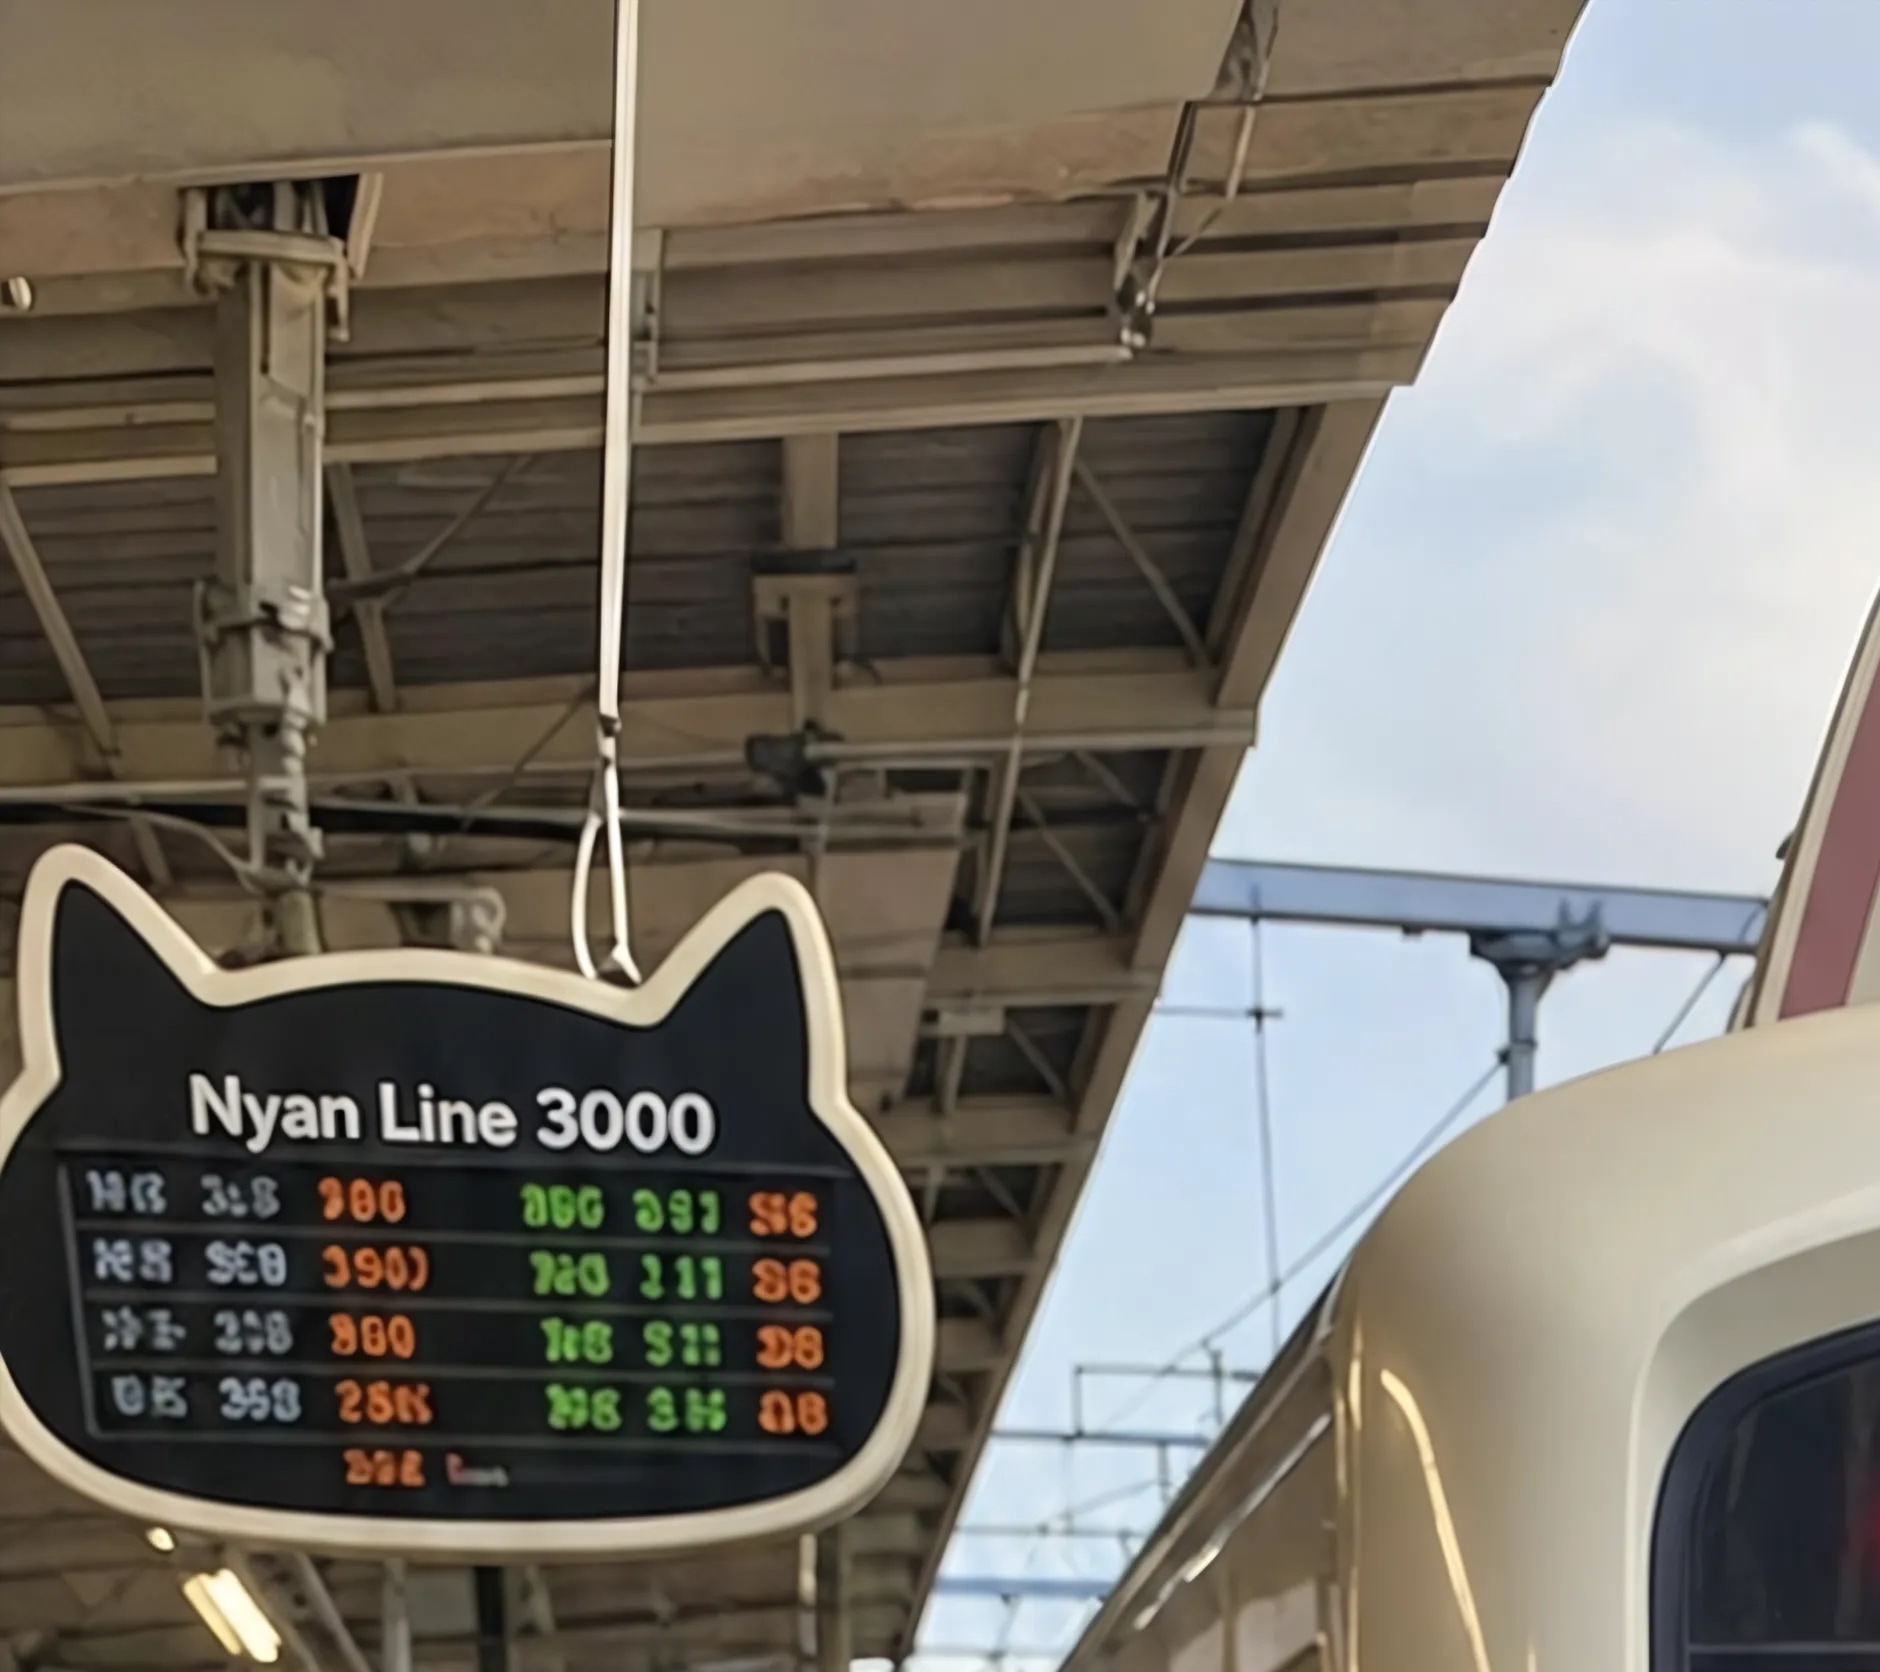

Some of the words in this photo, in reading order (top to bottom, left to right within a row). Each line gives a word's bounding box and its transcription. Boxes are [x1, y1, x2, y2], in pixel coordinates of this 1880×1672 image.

[189, 1073, 360, 1153] Nyan
[378, 1081, 519, 1147] Line
[535, 1086, 715, 1155] 3000
